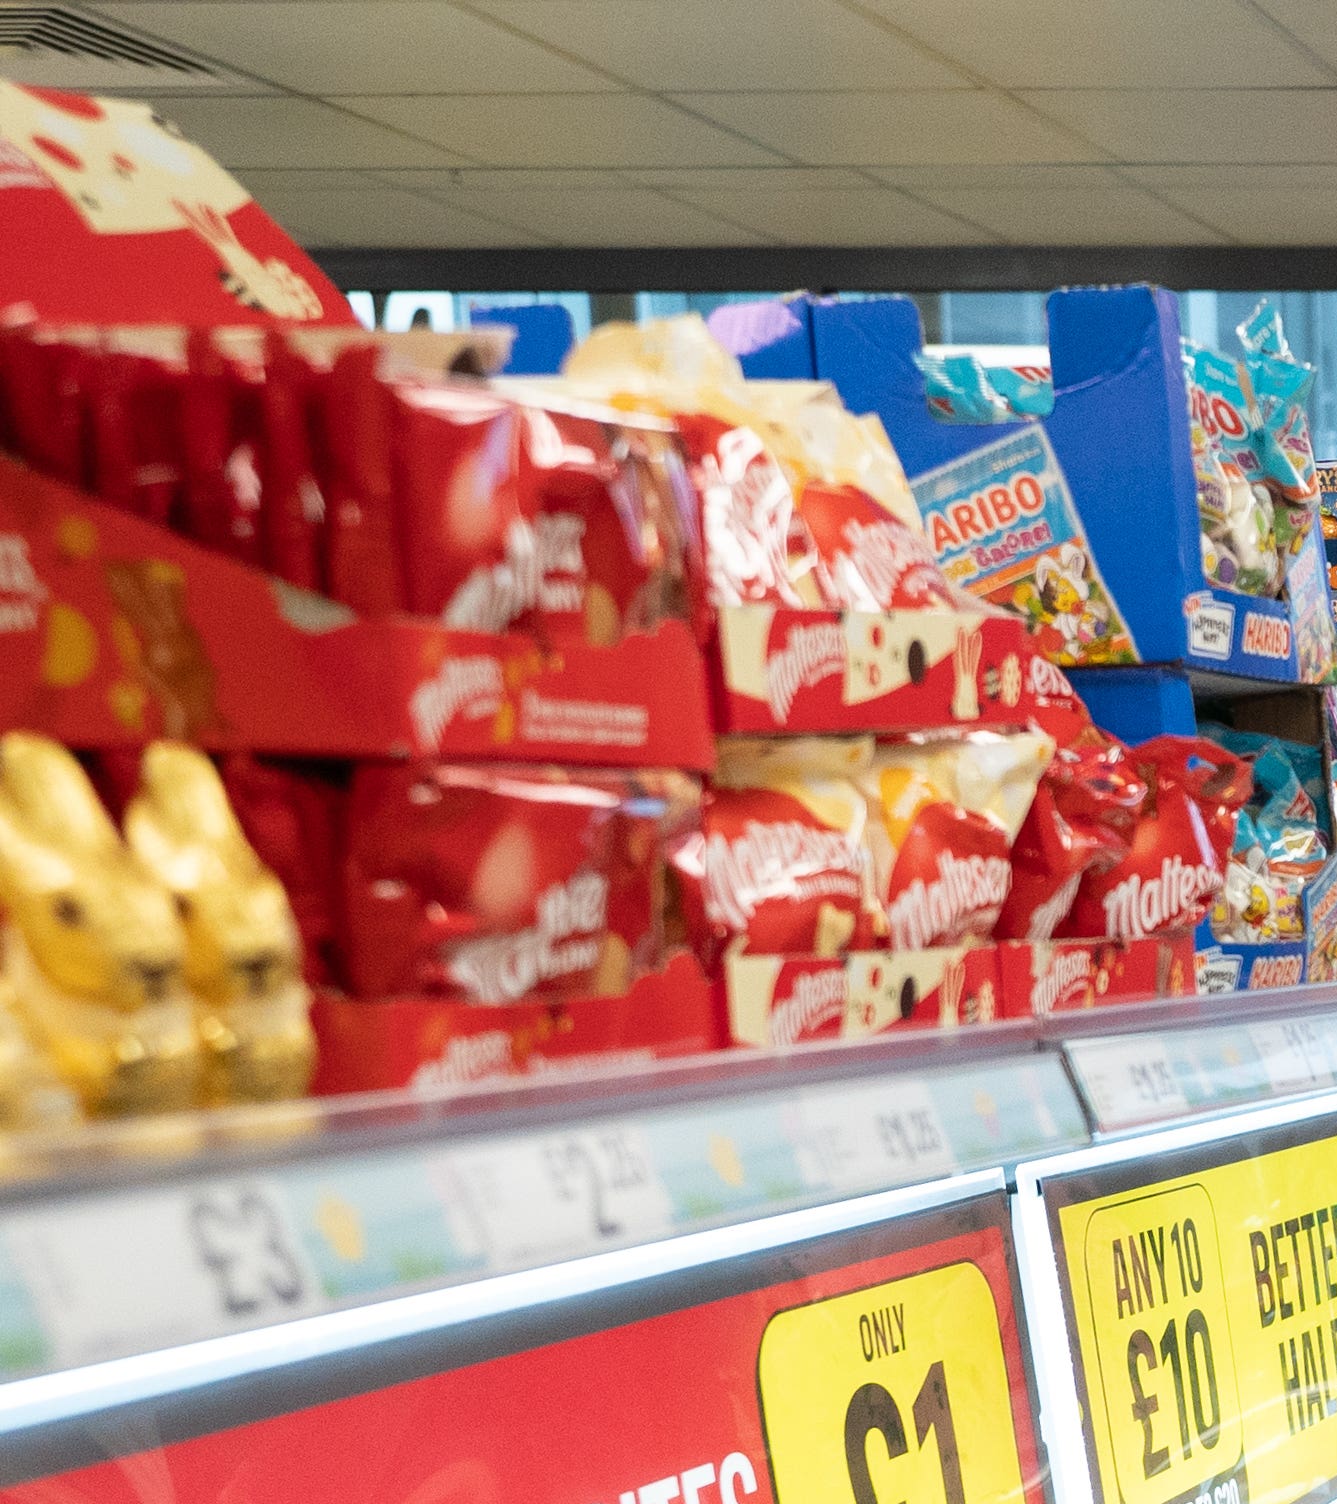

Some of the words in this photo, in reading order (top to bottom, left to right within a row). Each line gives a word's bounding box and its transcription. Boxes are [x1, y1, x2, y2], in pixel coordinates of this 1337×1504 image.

[931, 474, 1045, 554] ARIBO
[1244, 613, 1291, 658] HARIBO
[1111, 1225, 1168, 1321] ANY
[1170, 1217, 1205, 1297] 10
[857, 1304, 907, 1364] ONLY
[1127, 1308, 1222, 1480] £10
